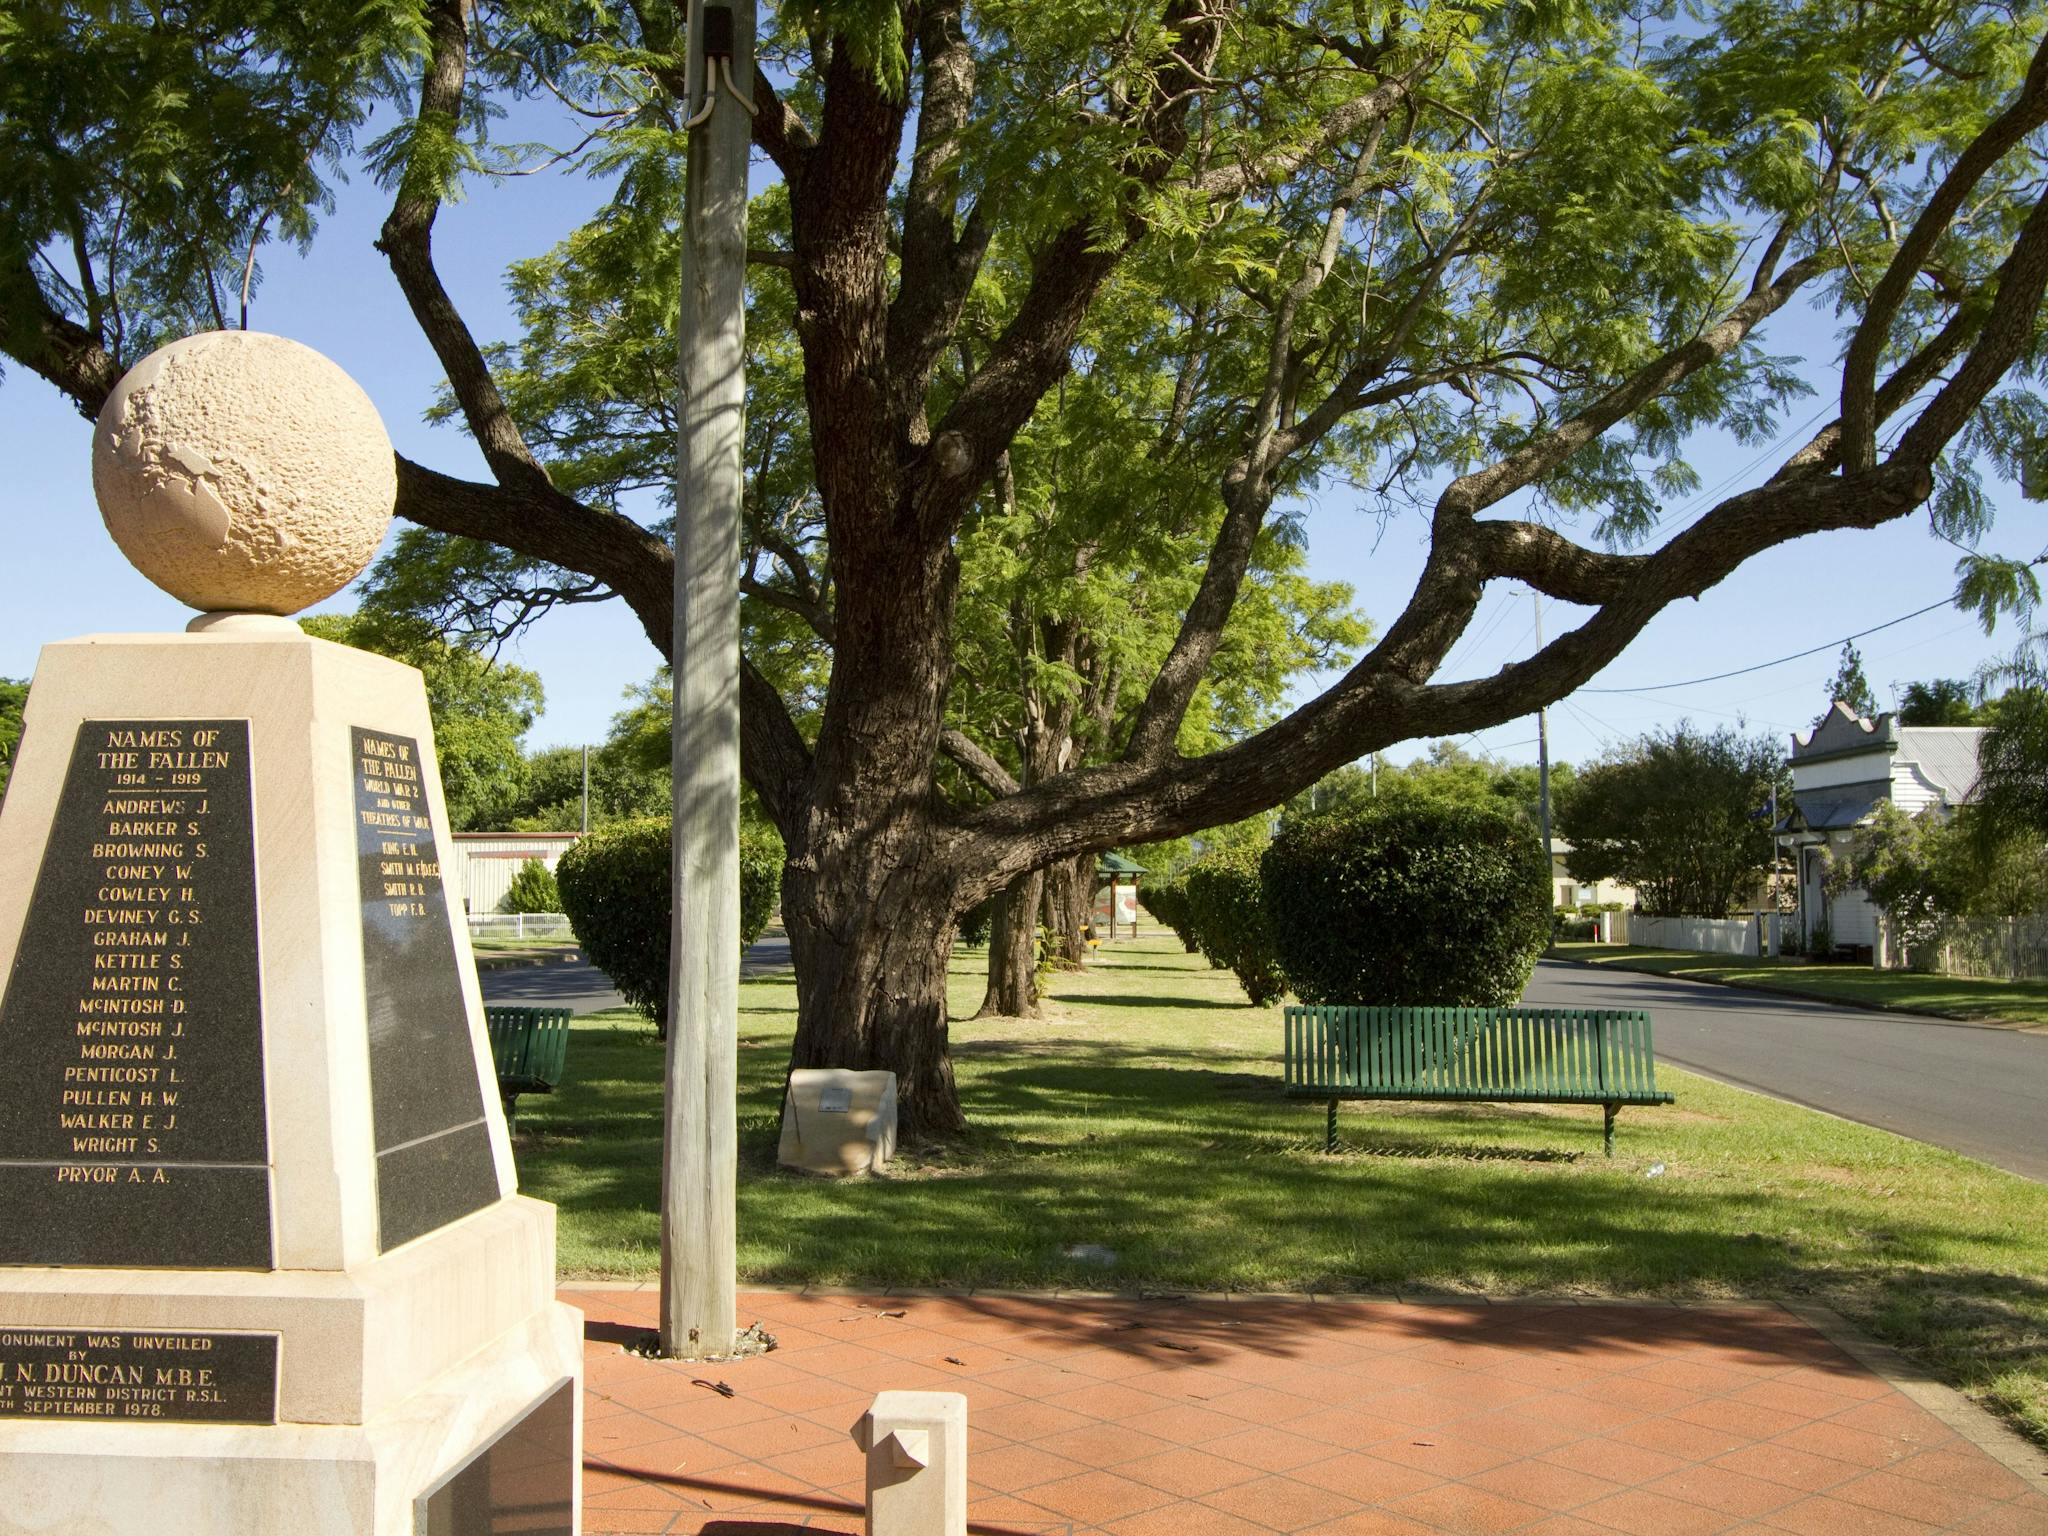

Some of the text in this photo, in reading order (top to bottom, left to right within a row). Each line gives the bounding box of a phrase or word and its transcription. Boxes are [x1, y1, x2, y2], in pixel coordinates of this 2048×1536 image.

[107, 730, 220, 748] NAMES OF
[363, 738, 408, 760] NAMES OF
[97, 752, 230, 769] THE FALLEN
[362, 758, 416, 780] THE FALLEN
[117, 774, 145, 785] 1914
[171, 774, 201, 785] 1919
[364, 779, 418, 798] WORLD WAR 2
[103, 800, 211, 814] ANDREWS J.
[361, 811, 430, 829] THEATRES OF WAR
[109, 822, 201, 836] BARKER S.
[92, 844, 210, 858] BROWNING S.
[382, 842, 399, 855] KING
[106, 865, 193, 879] CONEY W.
[381, 862, 403, 875] SMITH
[98, 887, 196, 902] COWLEY H.
[384, 883, 406, 896] SMITH
[84, 909, 203, 924] DEVINEY G. S.
[389, 903, 407, 916] TOPP
[93, 932, 190, 946] GRAHAM J.
[94, 954, 183, 970] KETTLE S.
[92, 977, 182, 992] MARTIN C.
[173, 1000, 188, 1015] D.
[171, 1022, 185, 1037] J.
[81, 1045, 176, 1060] MORGAN J.
[64, 1067, 184, 1083] PENTICOST L.
[62, 1091, 179, 1106] PULLEN H. W.
[60, 1114, 178, 1129] WALKER E. J.
[73, 1138, 161, 1153] WRIGHT S.
[57, 1168, 170, 1184] PRYOR A. A.
[88, 1336, 120, 1348] WAS
[133, 1337, 212, 1350] UNVEILED
[68, 1351, 86, 1361] BY
[16, 1363, 36, 1382] N.
[45, 1364, 144, 1385] DUNCAN
[155, 1368, 216, 1387] M.B.E.
[24, 1386, 97, 1399] WESTERN
[106, 1388, 177, 1400] DISTRICT
[186, 1389, 227, 1402] R.S.L.
[23, 1401, 115, 1415] SEPTEMBER
[125, 1403, 165, 1417] 1978.
